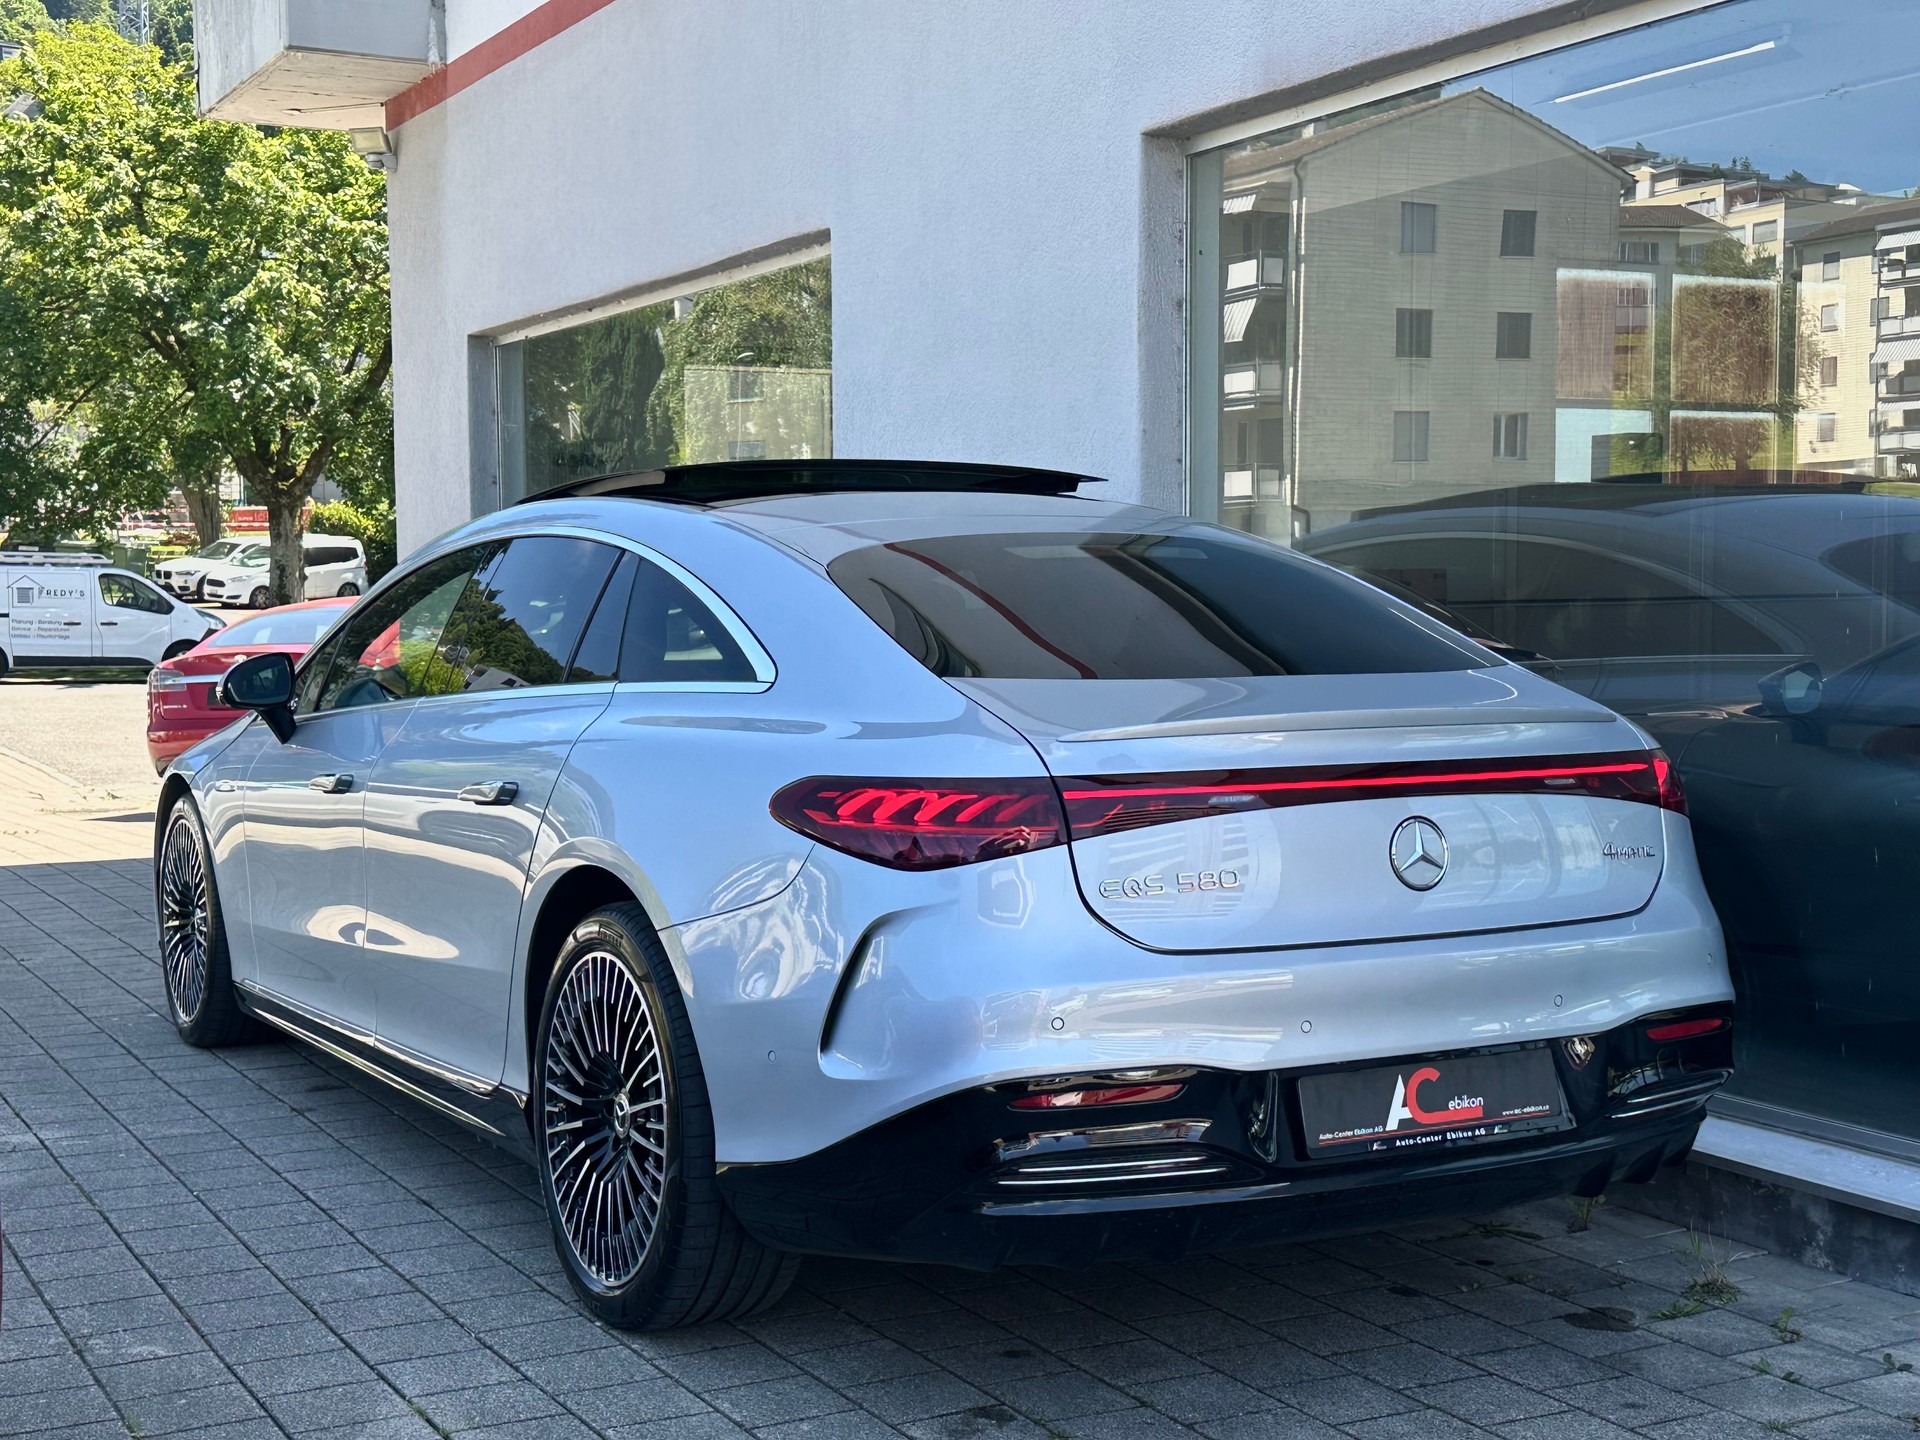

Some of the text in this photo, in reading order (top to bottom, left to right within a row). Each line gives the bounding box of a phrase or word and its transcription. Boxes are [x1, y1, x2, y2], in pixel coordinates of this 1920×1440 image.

[1099, 869, 1241, 899] EQS 580
[1448, 1095, 1484, 1110] ebikon
[1395, 1134, 1442, 1147] Auto-Center
[1446, 1129, 1473, 1140] Ebikon
[1475, 1127, 1486, 1136] AG
